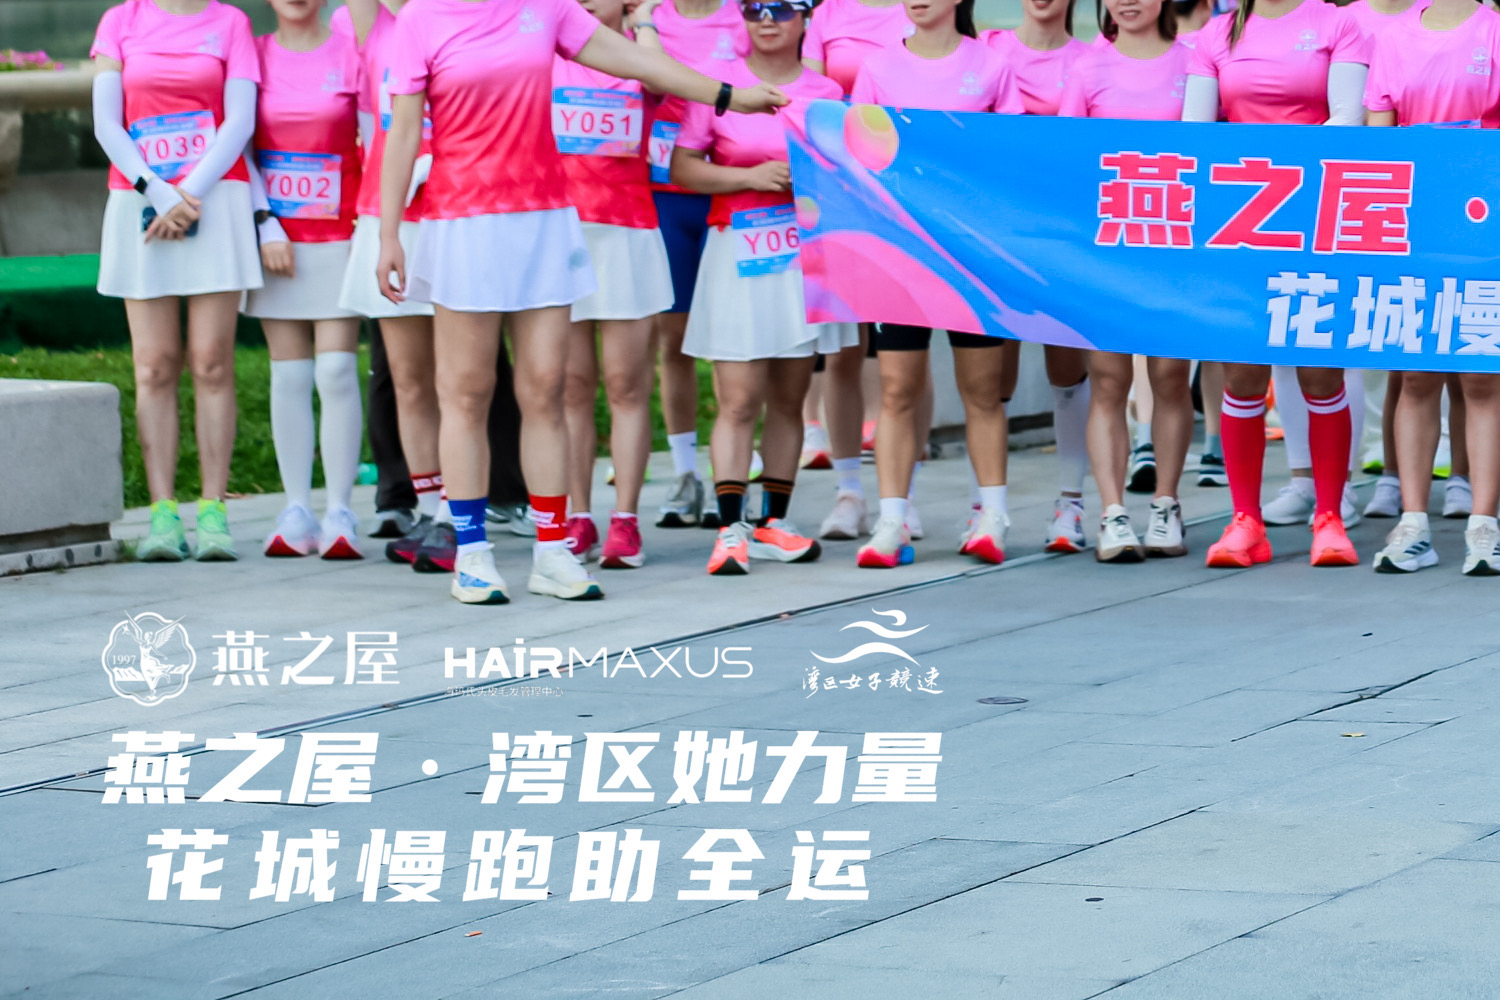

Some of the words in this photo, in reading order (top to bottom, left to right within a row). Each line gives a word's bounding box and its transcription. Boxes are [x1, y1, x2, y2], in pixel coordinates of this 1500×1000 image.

[560, 109, 632, 136] Y051
[139, 134, 206, 162] Y039
[264, 174, 331, 198] Y002
